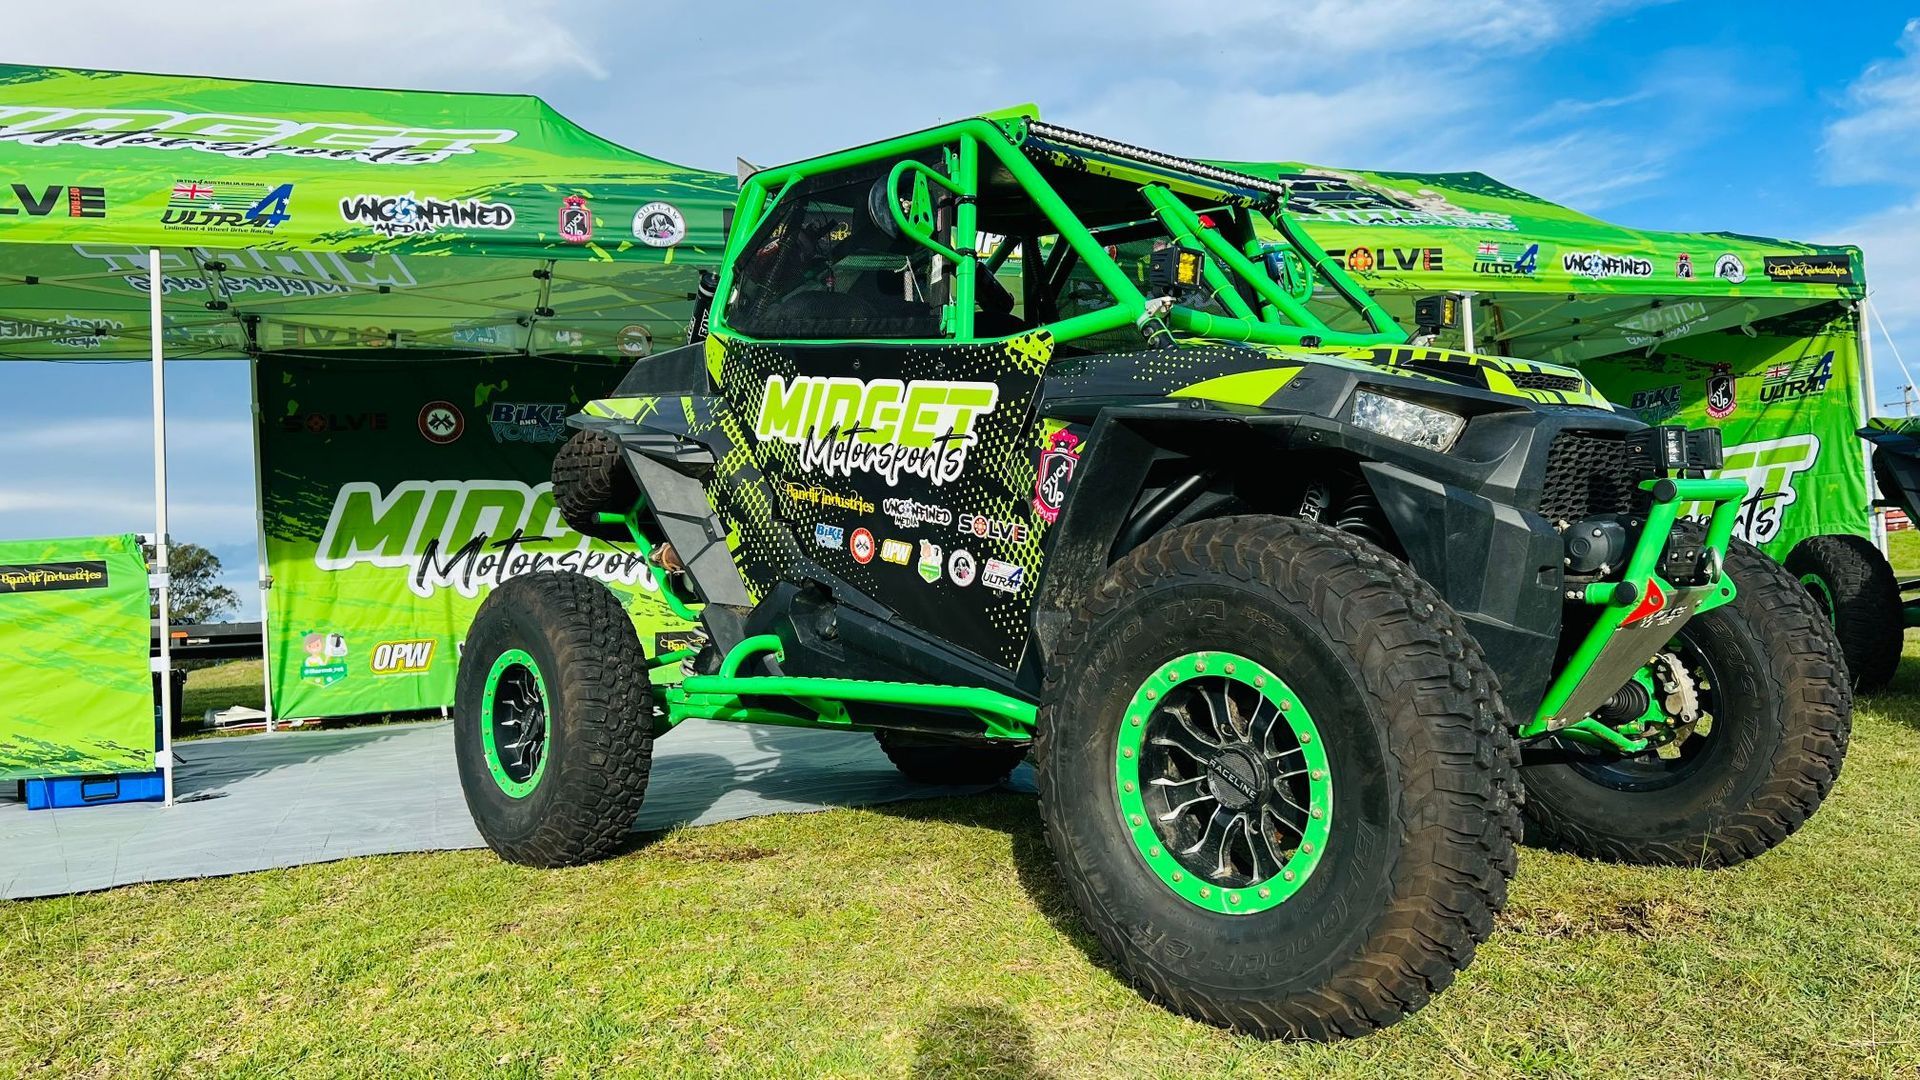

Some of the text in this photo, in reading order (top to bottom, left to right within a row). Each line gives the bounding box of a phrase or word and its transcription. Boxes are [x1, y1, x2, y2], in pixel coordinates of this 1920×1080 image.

[341, 195, 513, 227] UNCONFINED
[637, 203, 681, 220] OUTLAW
[375, 222, 432, 237] MEDIA
[757, 377, 998, 448] MIDGET
[803, 420, 974, 484] Motorsports
[1042, 460, 1070, 494] STUCK
[820, 488, 876, 517] Industries
[1048, 478, 1065, 508] UP
[884, 499, 951, 523] UNCONFINED
[895, 513, 918, 528] MEDIA
[1031, 498, 1059, 521] INDUST
[959, 514, 1027, 543] SOLVE
[373, 642, 432, 670] OPW
[1208, 759, 1258, 799] RACELINE
